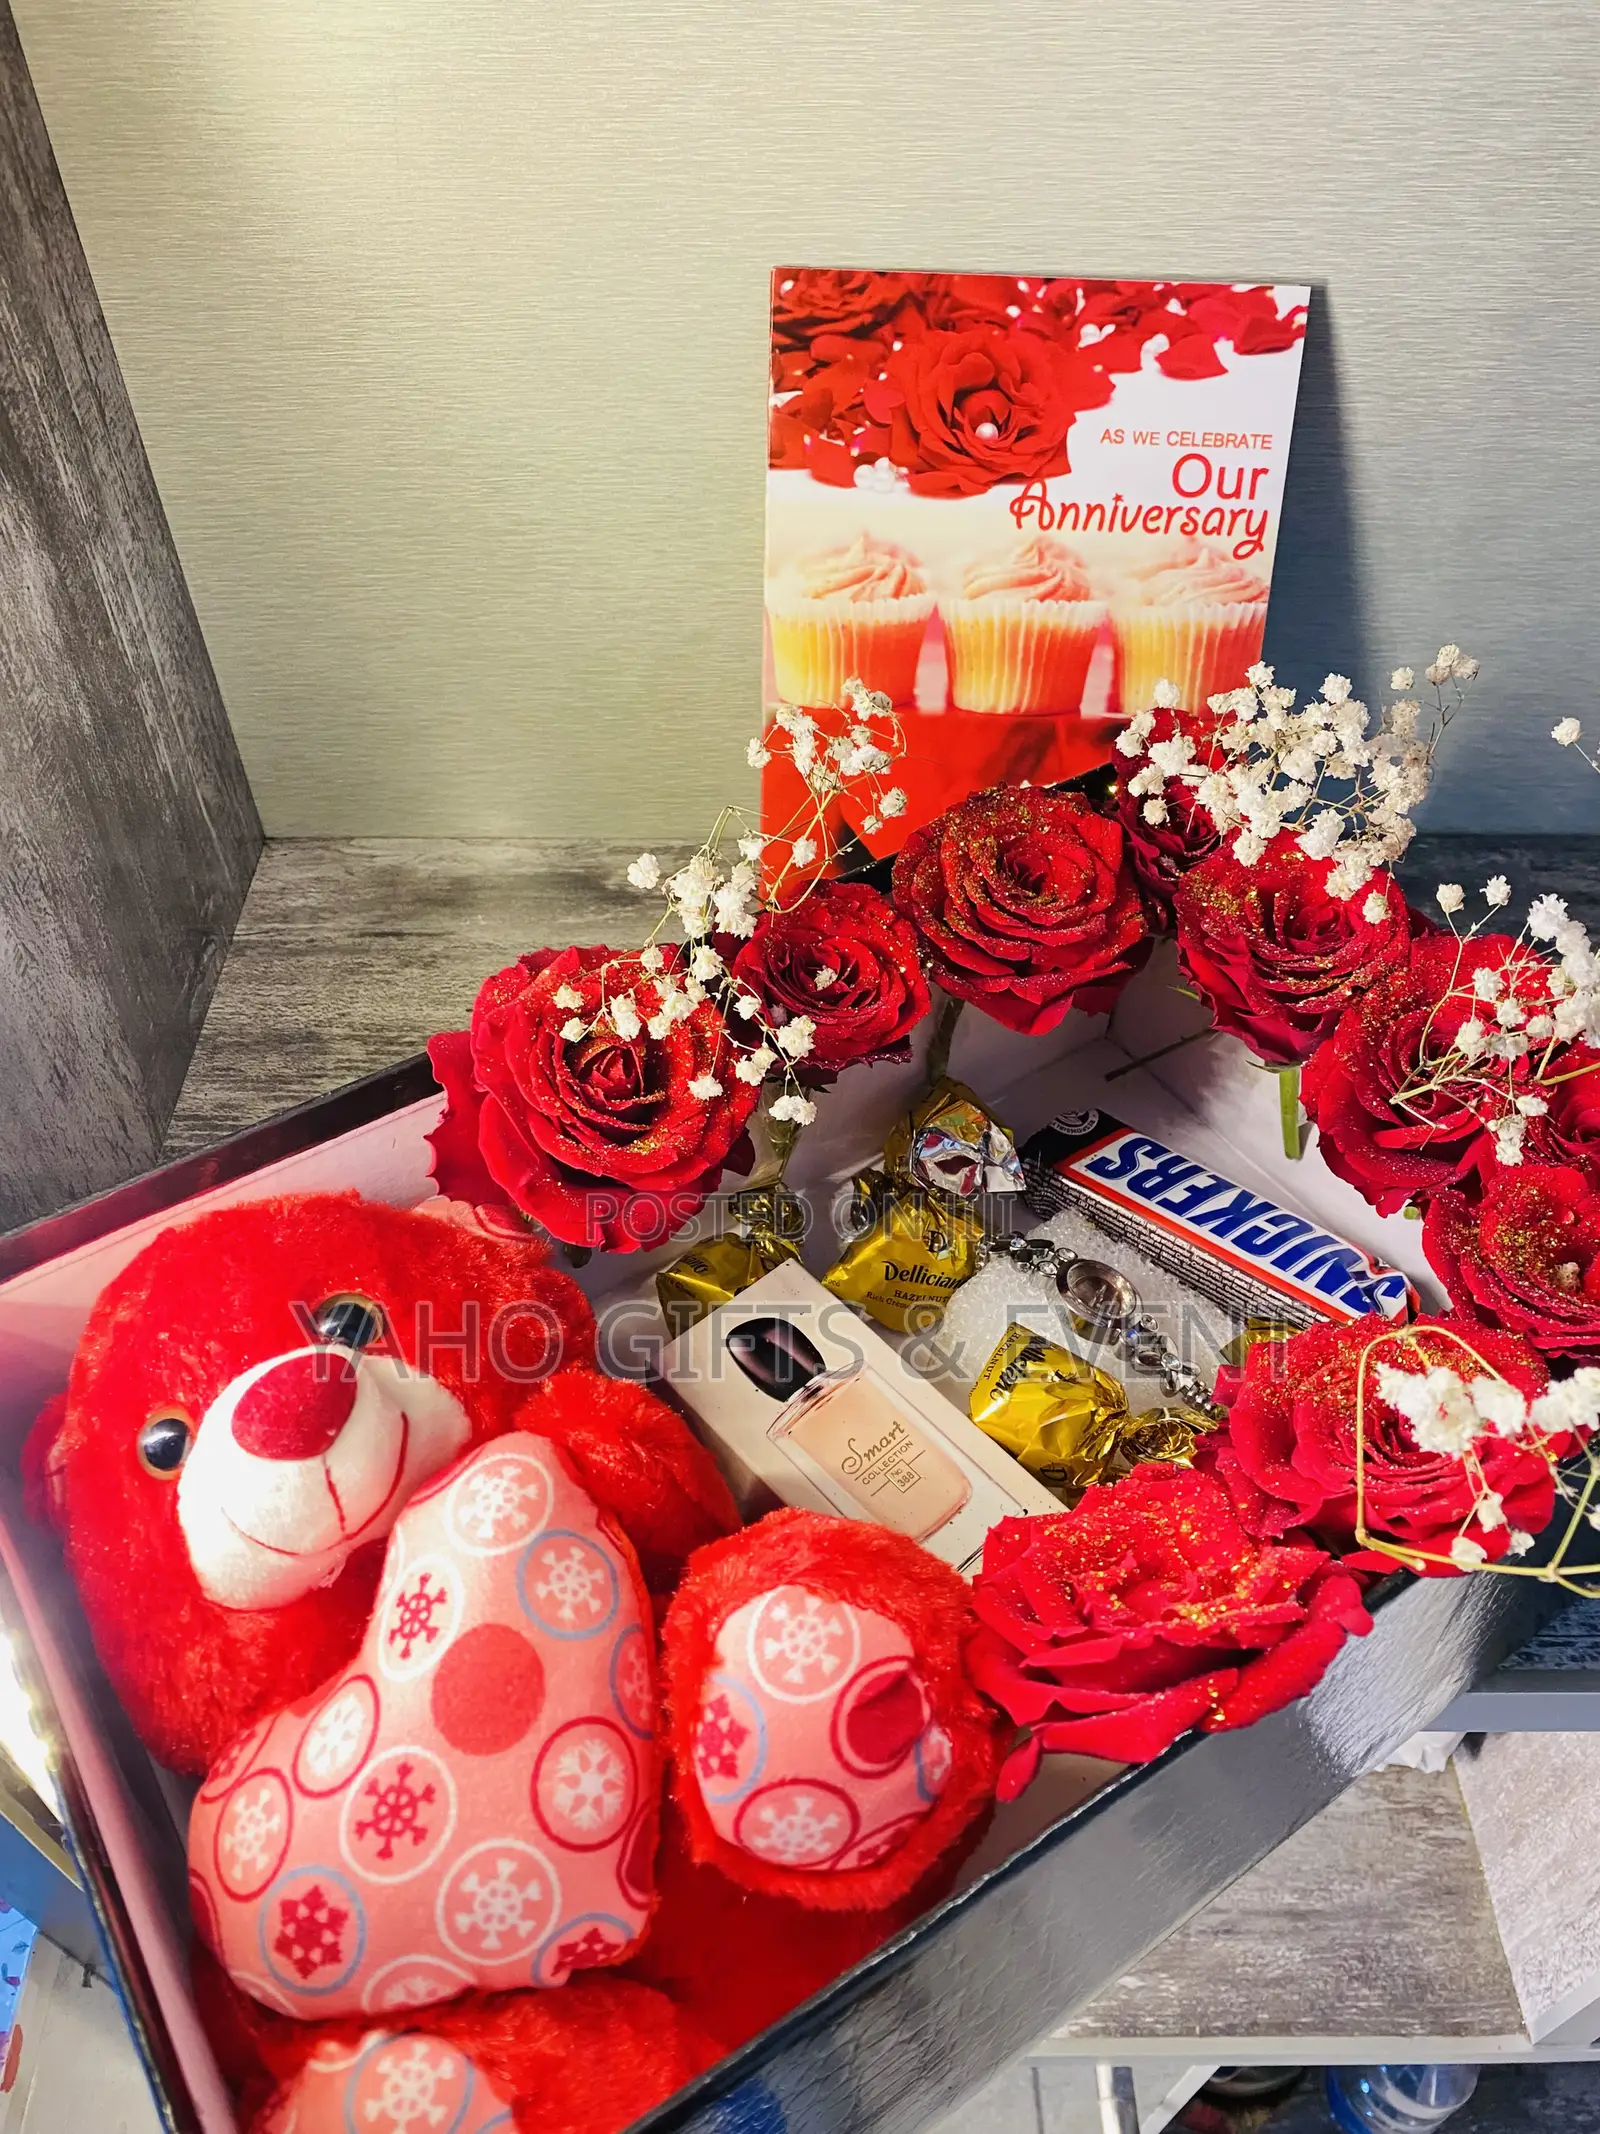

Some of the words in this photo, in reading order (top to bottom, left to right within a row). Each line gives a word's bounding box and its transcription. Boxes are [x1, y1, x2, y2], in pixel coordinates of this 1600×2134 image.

[1100, 428, 1124, 444] AS
[1132, 430, 1160, 446] WE
[1166, 430, 1273, 450] CELEBRATE
[1171, 452, 1270, 500] Our
[1009, 478, 1269, 560] Anniversary
[1085, 1136, 1405, 1314] SNICKERS
[841, 1420, 905, 1475] Smart
[861, 1440, 914, 1485] COLLECTION
[897, 1471, 915, 1487] 388
